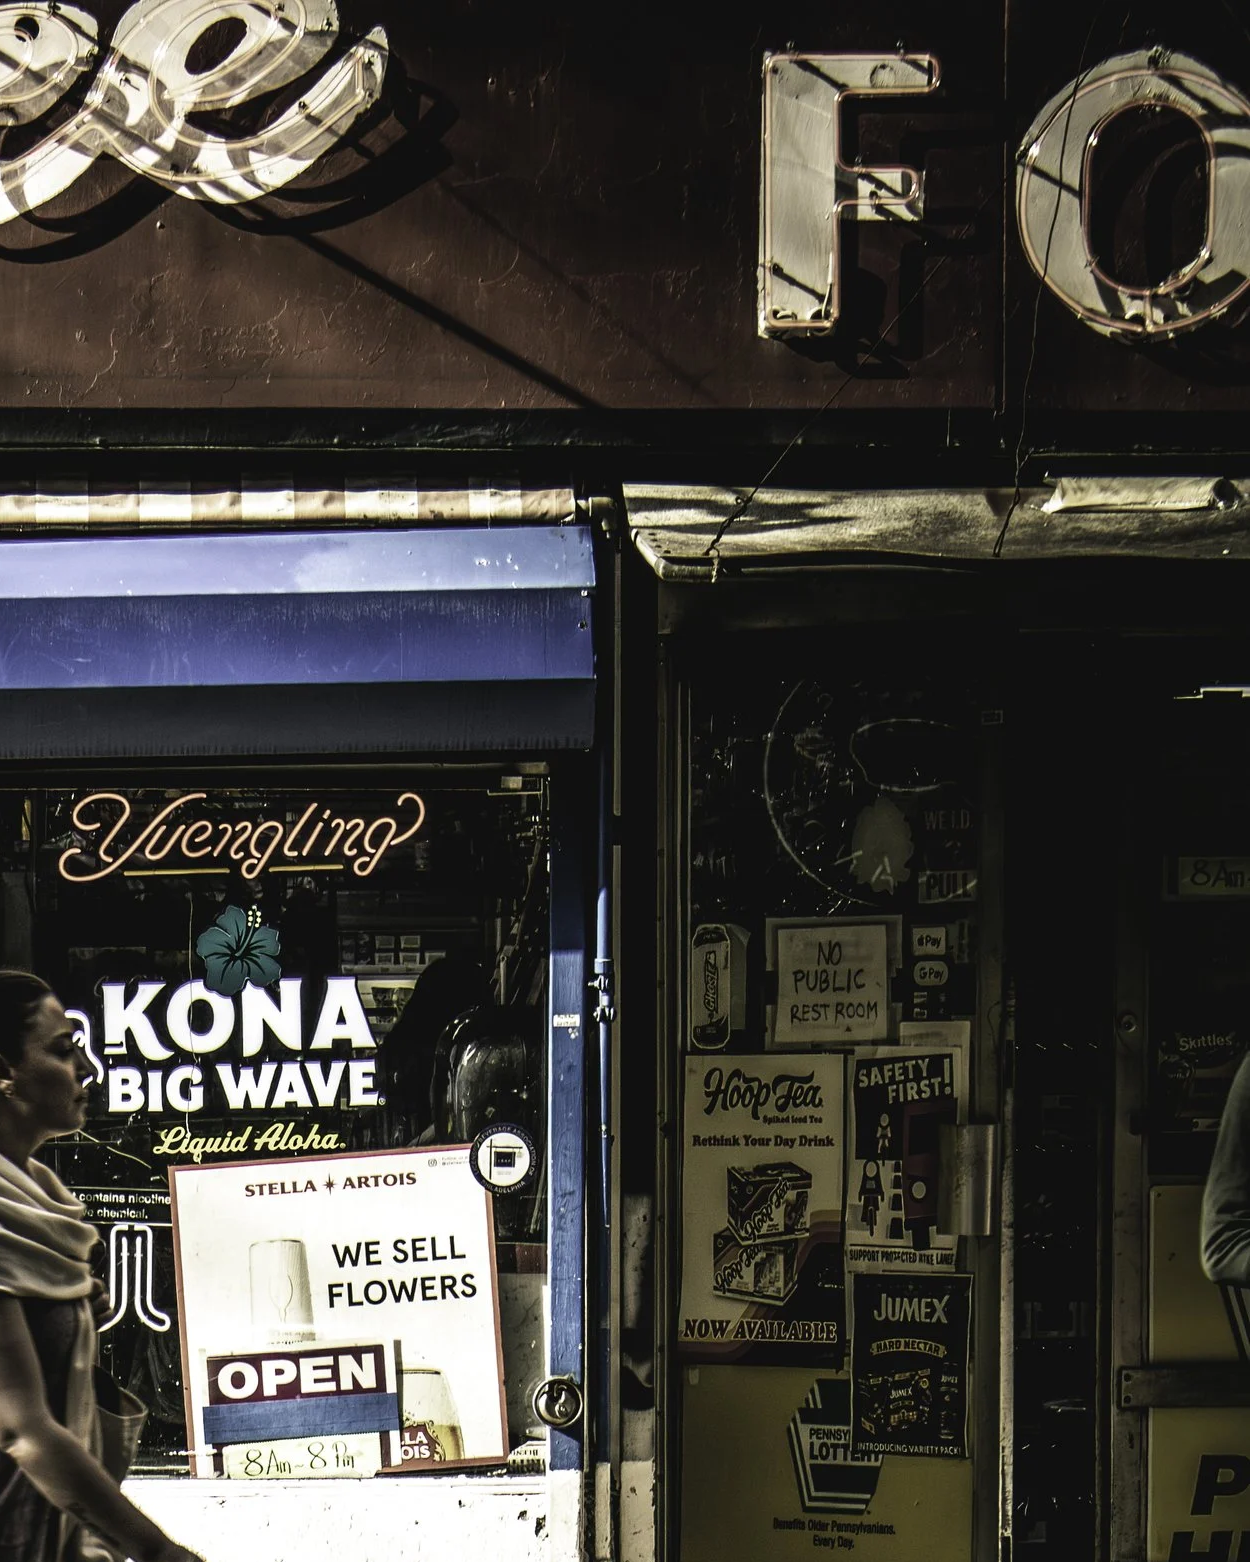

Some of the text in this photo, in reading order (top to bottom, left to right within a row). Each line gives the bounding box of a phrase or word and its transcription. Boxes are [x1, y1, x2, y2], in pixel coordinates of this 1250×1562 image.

[57, 791, 427, 883] Yuengling
[817, 940, 843, 967] NO
[792, 968, 867, 995] PUBLIC
[100, 975, 377, 1062] KONA
[1178, 1033, 1233, 1052] Skittles
[857, 1057, 930, 1088] SAFETY
[108, 1058, 381, 1115] BIG WAVE
[703, 1066, 824, 1120] Hoop Tea
[762, 1115, 790, 1125] Spiked
[809, 1115, 823, 1124] Tea
[153, 1124, 249, 1163] Liquid
[692, 1134, 835, 1149] Rethink Your Day Drink
[244, 1170, 417, 1198] STELLA ARTOIS
[79, 1192, 126, 1204] contains
[128, 1193, 171, 1205] nicotine
[96, 1207, 149, 1219] chemical.
[331, 1234, 467, 1269] WE SELL
[849, 1249, 880, 1262] SUPPORT
[881, 1250, 917, 1263] PROTECTED
[328, 1273, 478, 1309] FLOWERS
[872, 1292, 950, 1324] JUMEX
[683, 1318, 838, 1344] NOW AVAILABLE
[876, 1339, 940, 1354] HARD NECTAR
[216, 1351, 378, 1400] OPEN
[857, 1441, 908, 1453] INTRODUCING
[909, 1444, 939, 1455] VARIETY
[773, 1516, 897, 1535] Benefits Older Pennsylvanians.
[812, 1533, 836, 1550] Every
